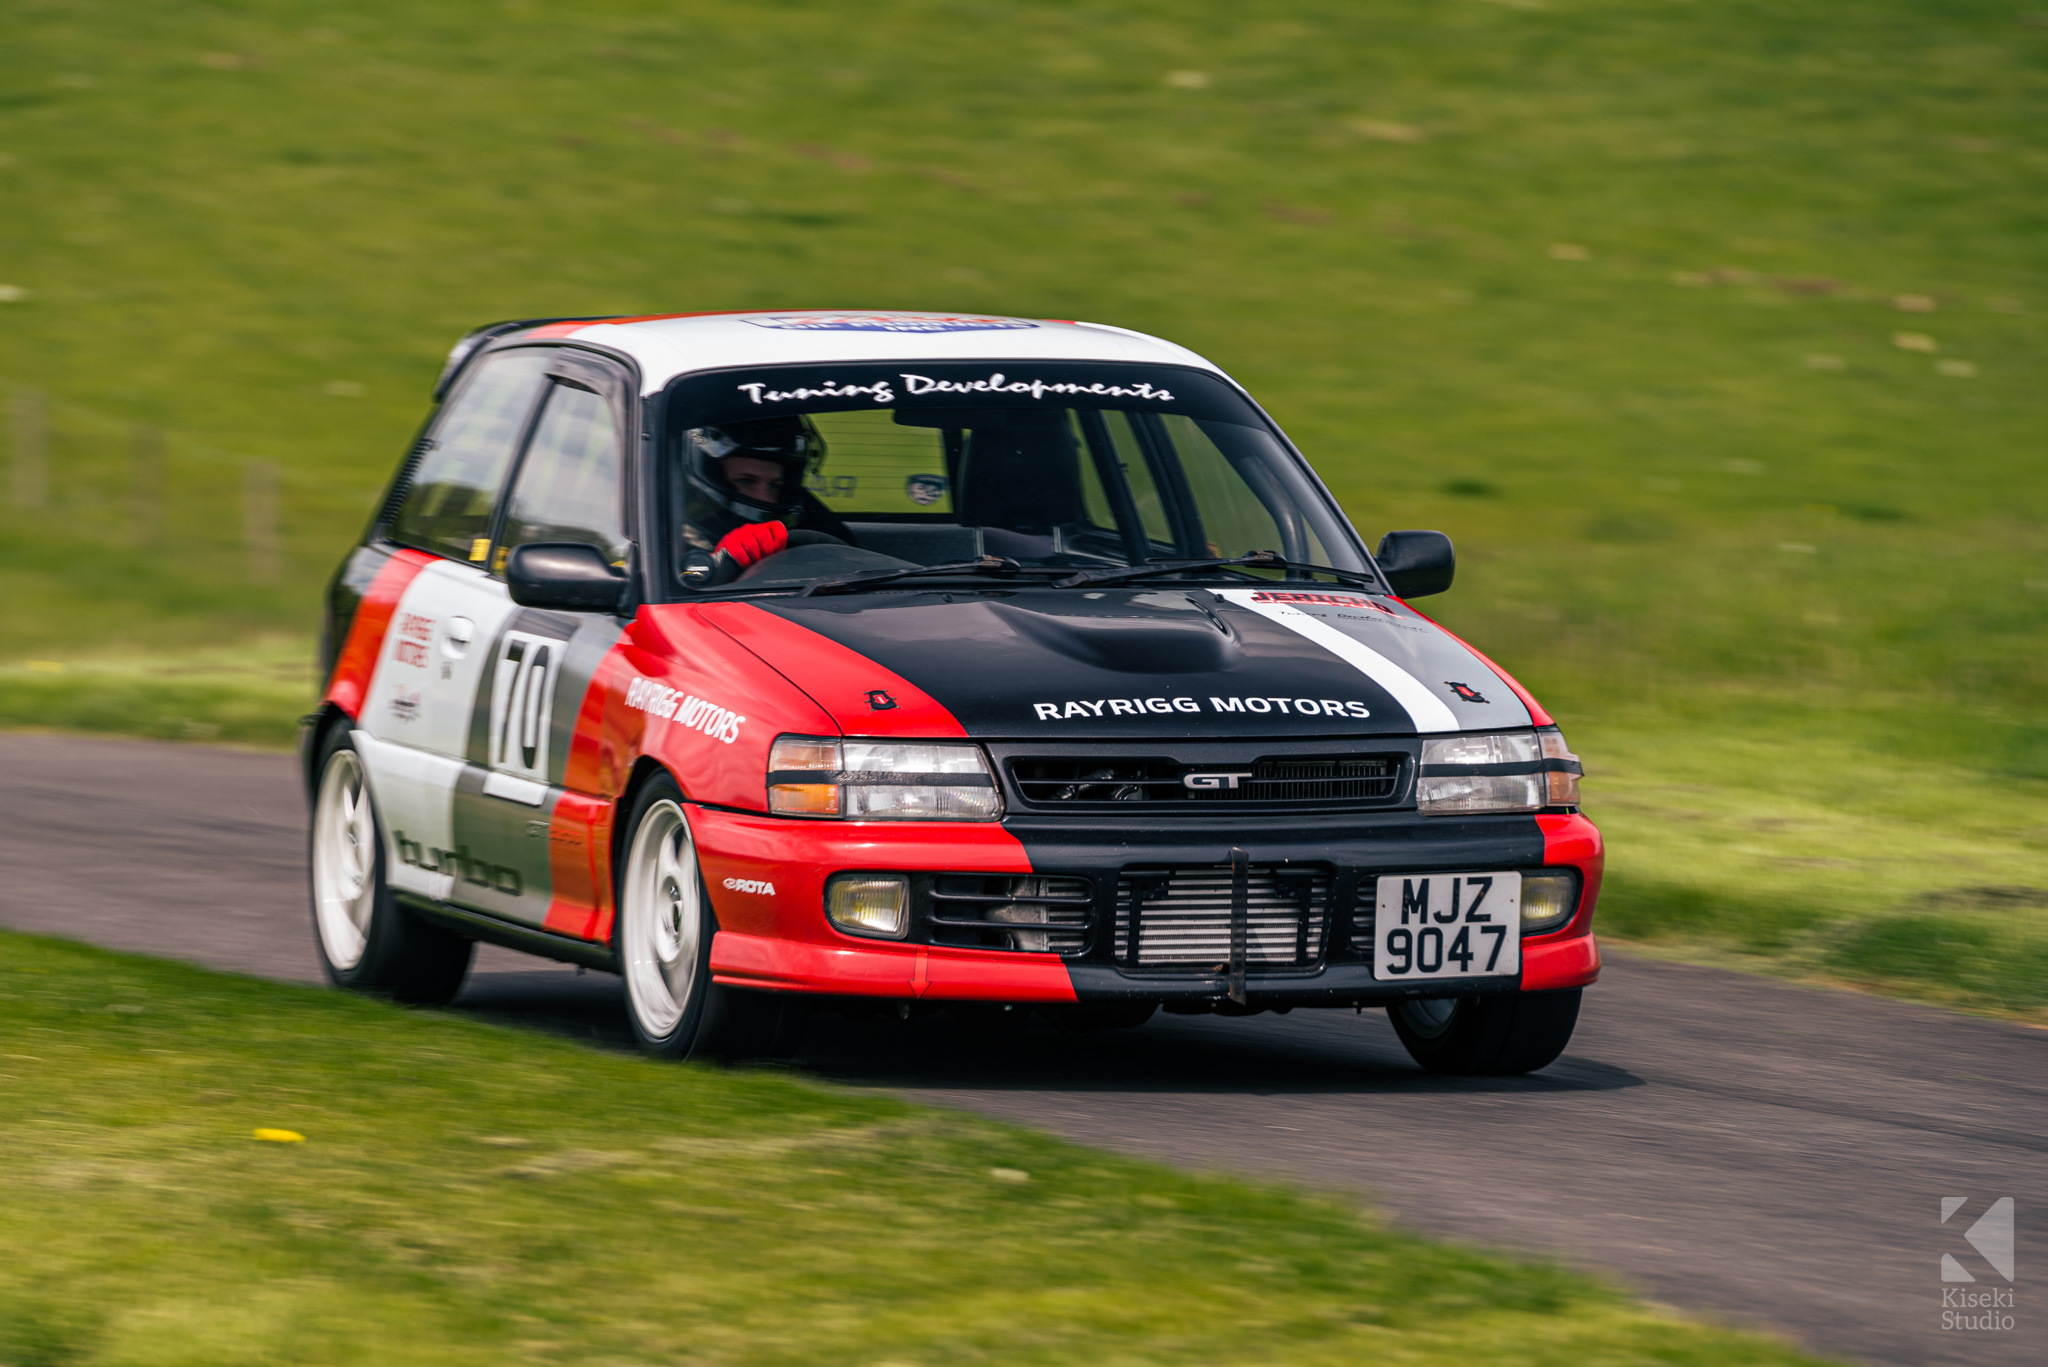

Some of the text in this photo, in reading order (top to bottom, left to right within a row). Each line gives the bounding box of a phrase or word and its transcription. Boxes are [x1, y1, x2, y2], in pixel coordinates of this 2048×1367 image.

[737, 373, 1175, 403] Tuning Developments
[499, 638, 550, 769] 70
[672, 695, 747, 744] MOTORS
[1033, 697, 1371, 720] RAYRIGG MOTORS
[1183, 772, 1253, 789] GT
[394, 829, 523, 896] turbo
[735, 878, 776, 896] ROTA
[1401, 876, 1493, 924] MJZ
[1386, 925, 1507, 974] 9047
